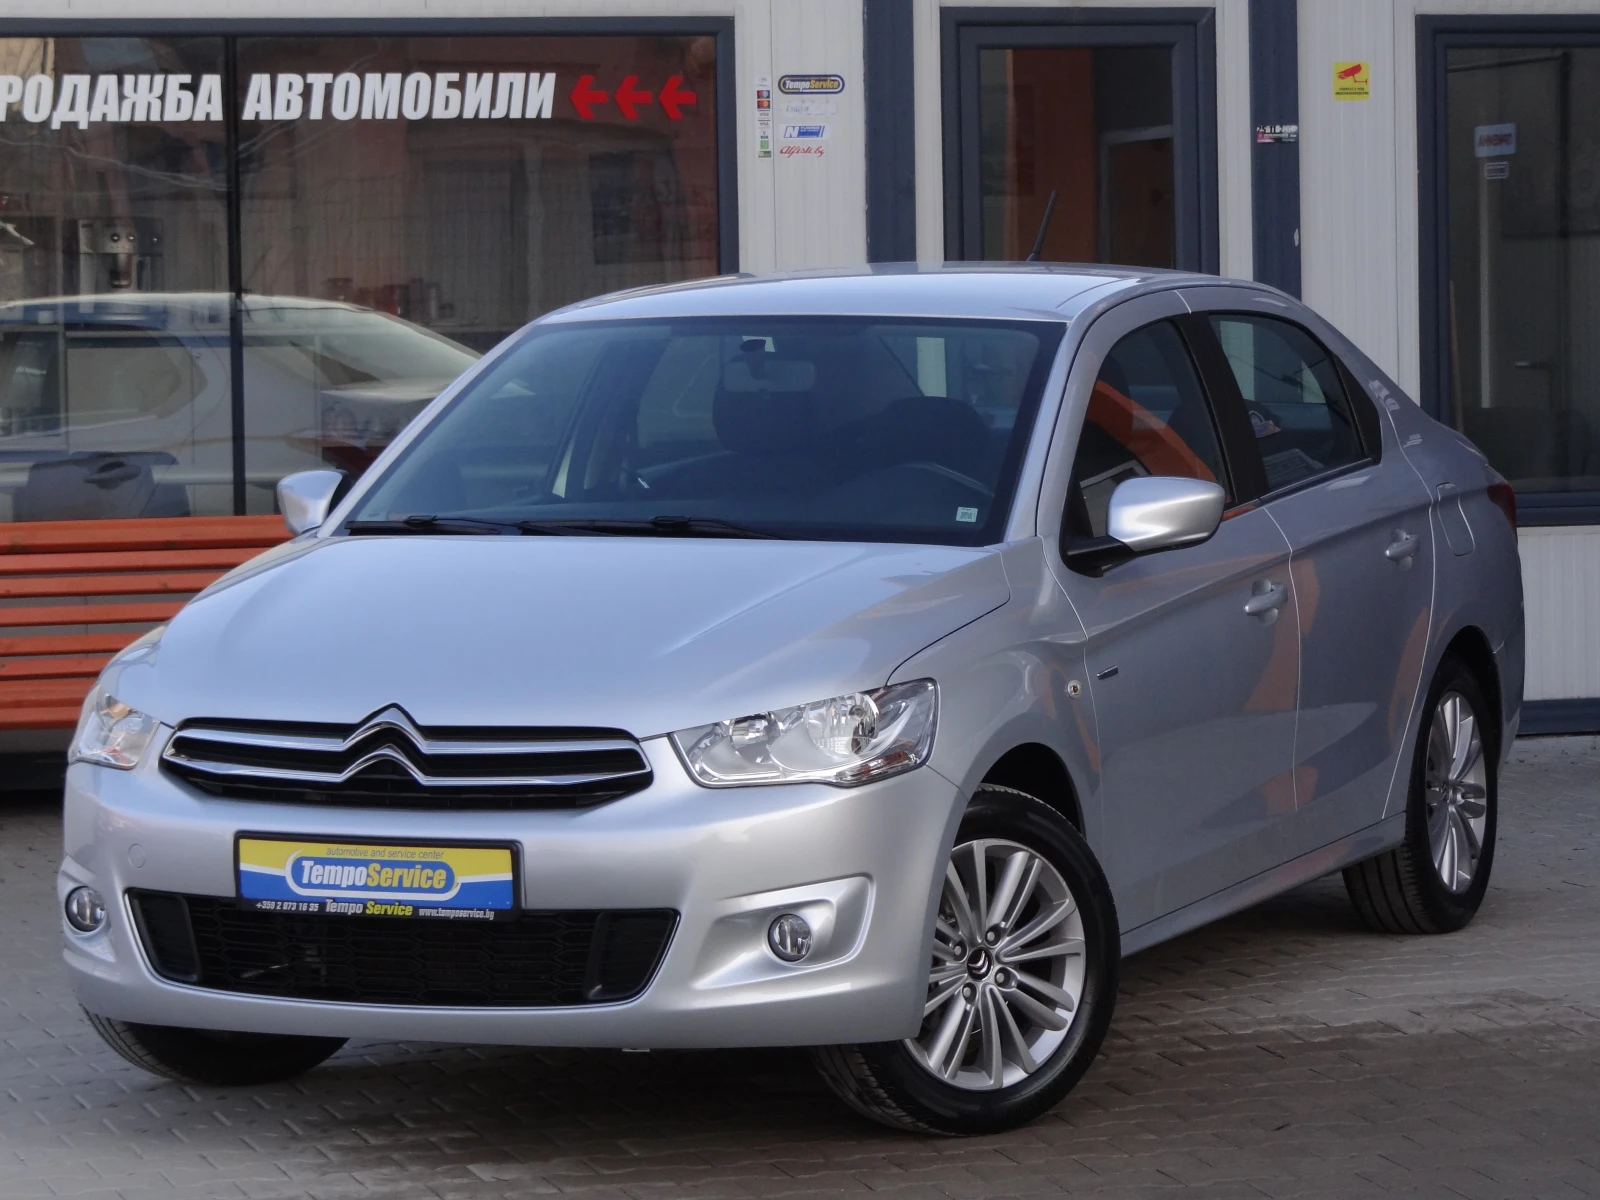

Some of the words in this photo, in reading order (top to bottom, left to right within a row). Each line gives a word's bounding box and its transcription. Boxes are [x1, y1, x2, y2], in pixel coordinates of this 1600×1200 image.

[242, 72, 556, 121] АВТОМОБИЛИ
[785, 79, 839, 92] TempoService
[326, 847, 369, 857] automotive
[370, 848, 385, 858] and
[387, 849, 416, 859] service
[418, 850, 444, 860] center
[301, 860, 447, 890] TempoService
[256, 900, 276, 910] +359
[276, 901, 282, 910] 2
[283, 902, 297, 911] 973
[325, 898, 363, 915] Tempo
[365, 900, 413, 916] Service
[418, 908, 495, 920] www.temposervice.bg
